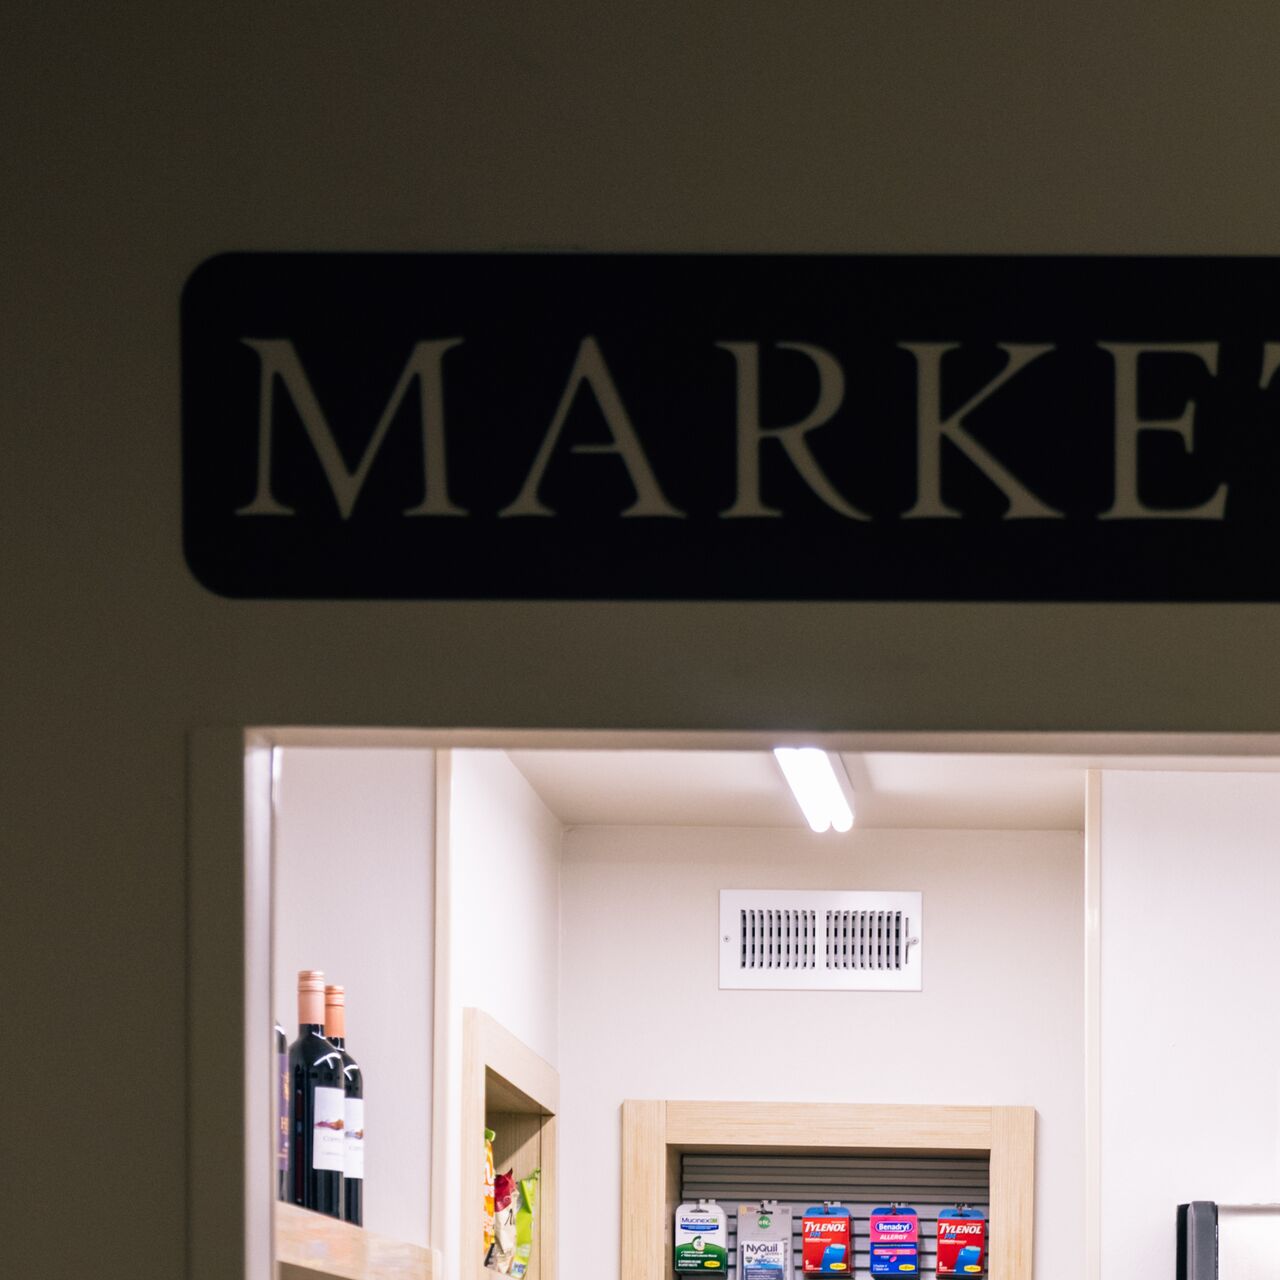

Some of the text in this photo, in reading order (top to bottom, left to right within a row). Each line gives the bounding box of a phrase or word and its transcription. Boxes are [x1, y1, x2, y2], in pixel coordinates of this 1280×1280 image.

[804, 1221, 846, 1232] TYLENOL
[878, 1223, 909, 1232] Benadryl
[939, 1222, 982, 1234] TYLENOL
[746, 1243, 778, 1255] NyQuil
